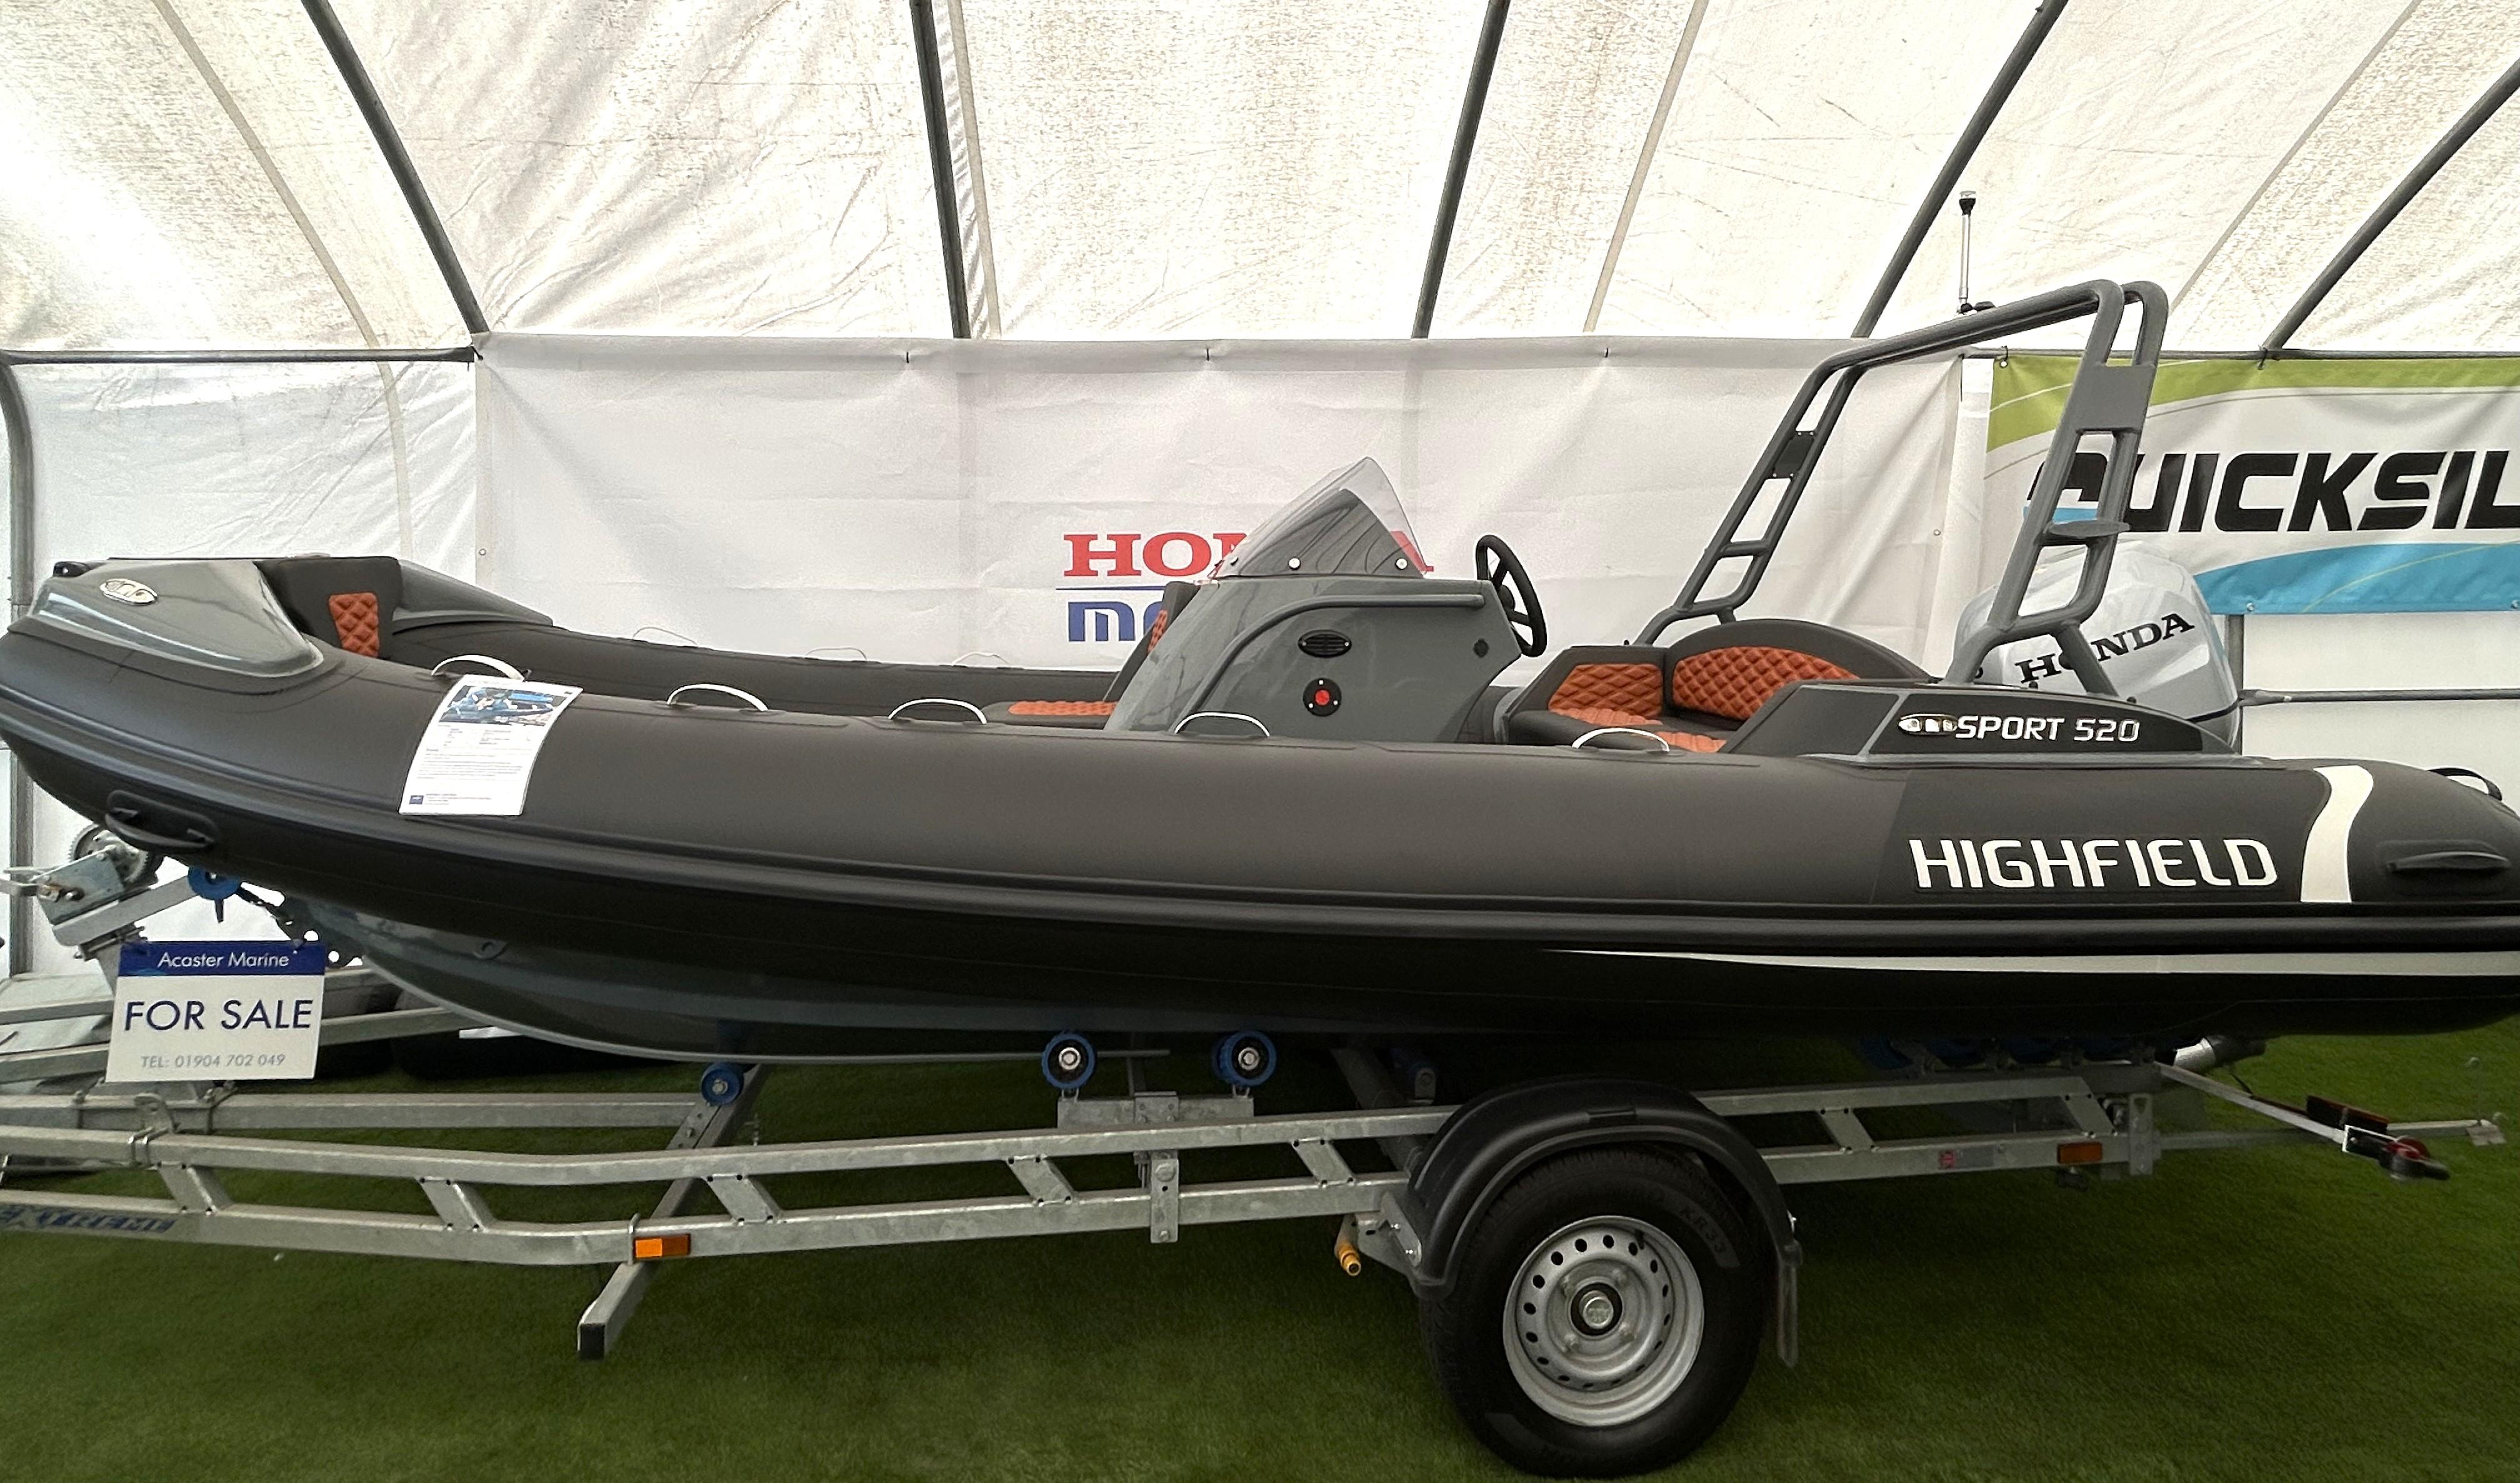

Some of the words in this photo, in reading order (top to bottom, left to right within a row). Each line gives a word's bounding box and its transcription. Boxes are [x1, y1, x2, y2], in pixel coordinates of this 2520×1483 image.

[1955, 716, 2065, 741] SPORT
[2073, 718, 2141, 742] 520
[1908, 839, 2278, 888] HIGHFIELD
[158, 952, 224, 967] Acaster
[228, 951, 289, 967] Marine
[124, 1000, 205, 1031] FOR
[221, 999, 313, 1030] SALE
[141, 1056, 169, 1069] TEL:
[175, 1054, 220, 1067] 01904
[225, 1054, 256, 1067] 702
[258, 1053, 286, 1067] 049
